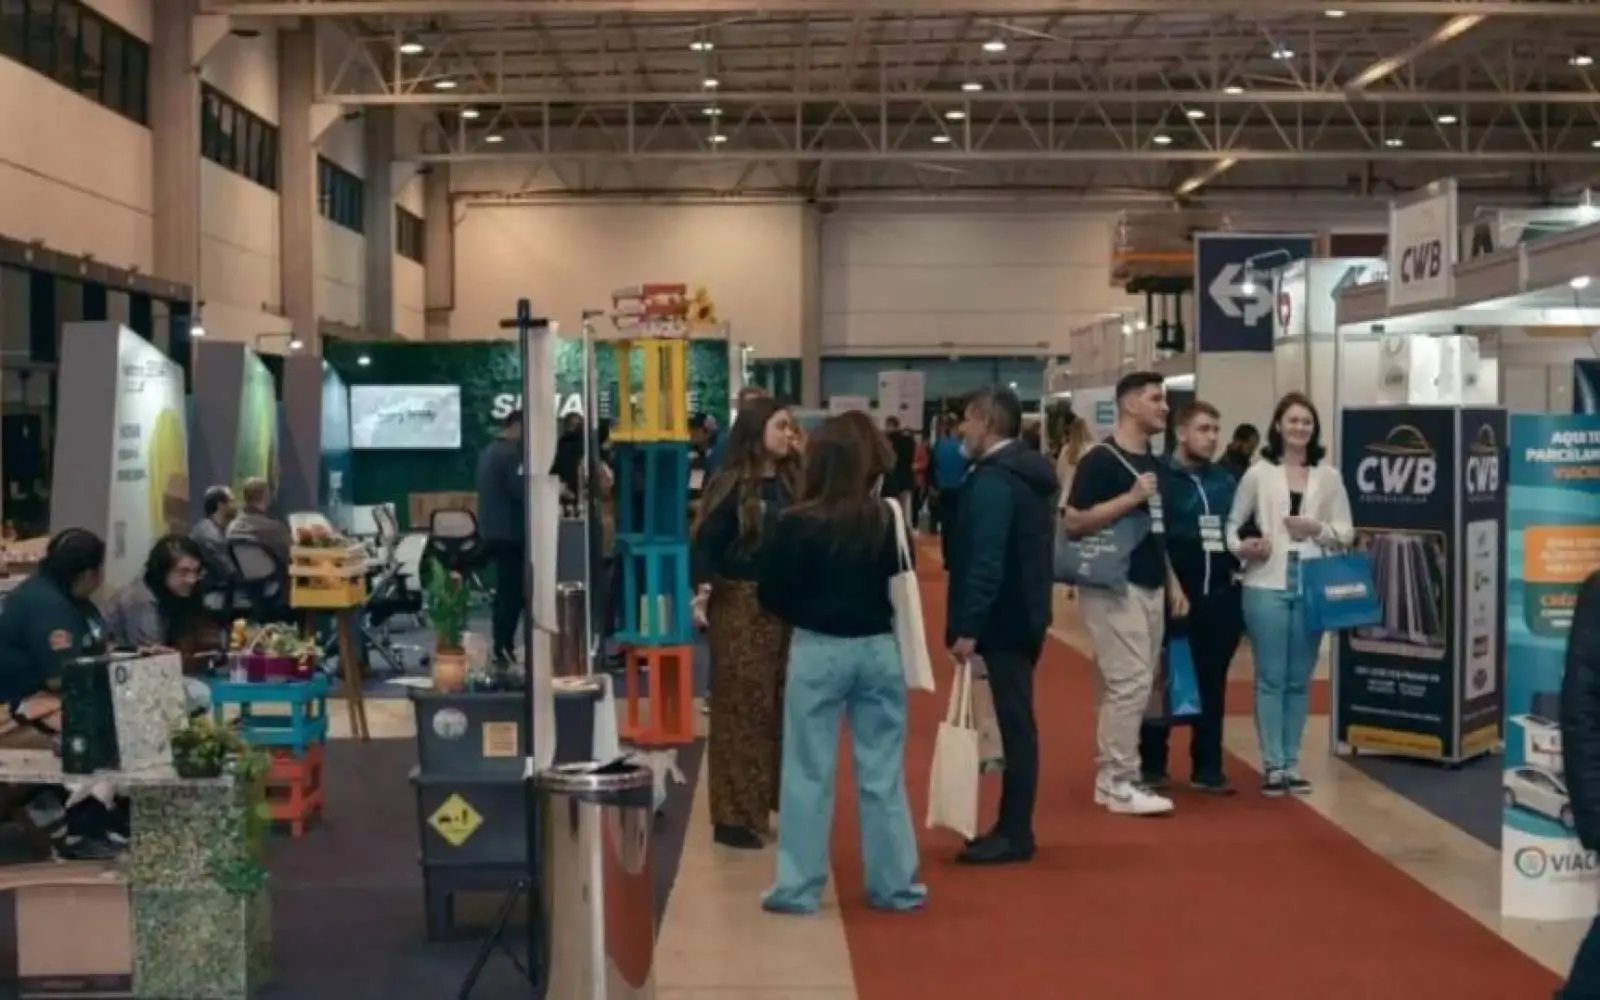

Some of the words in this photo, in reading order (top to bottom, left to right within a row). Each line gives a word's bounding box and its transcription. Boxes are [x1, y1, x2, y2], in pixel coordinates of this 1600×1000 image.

[1401, 240, 1442, 284] CWB
[1357, 456, 1436, 494] CWB
[1466, 456, 1499, 493] CWB
